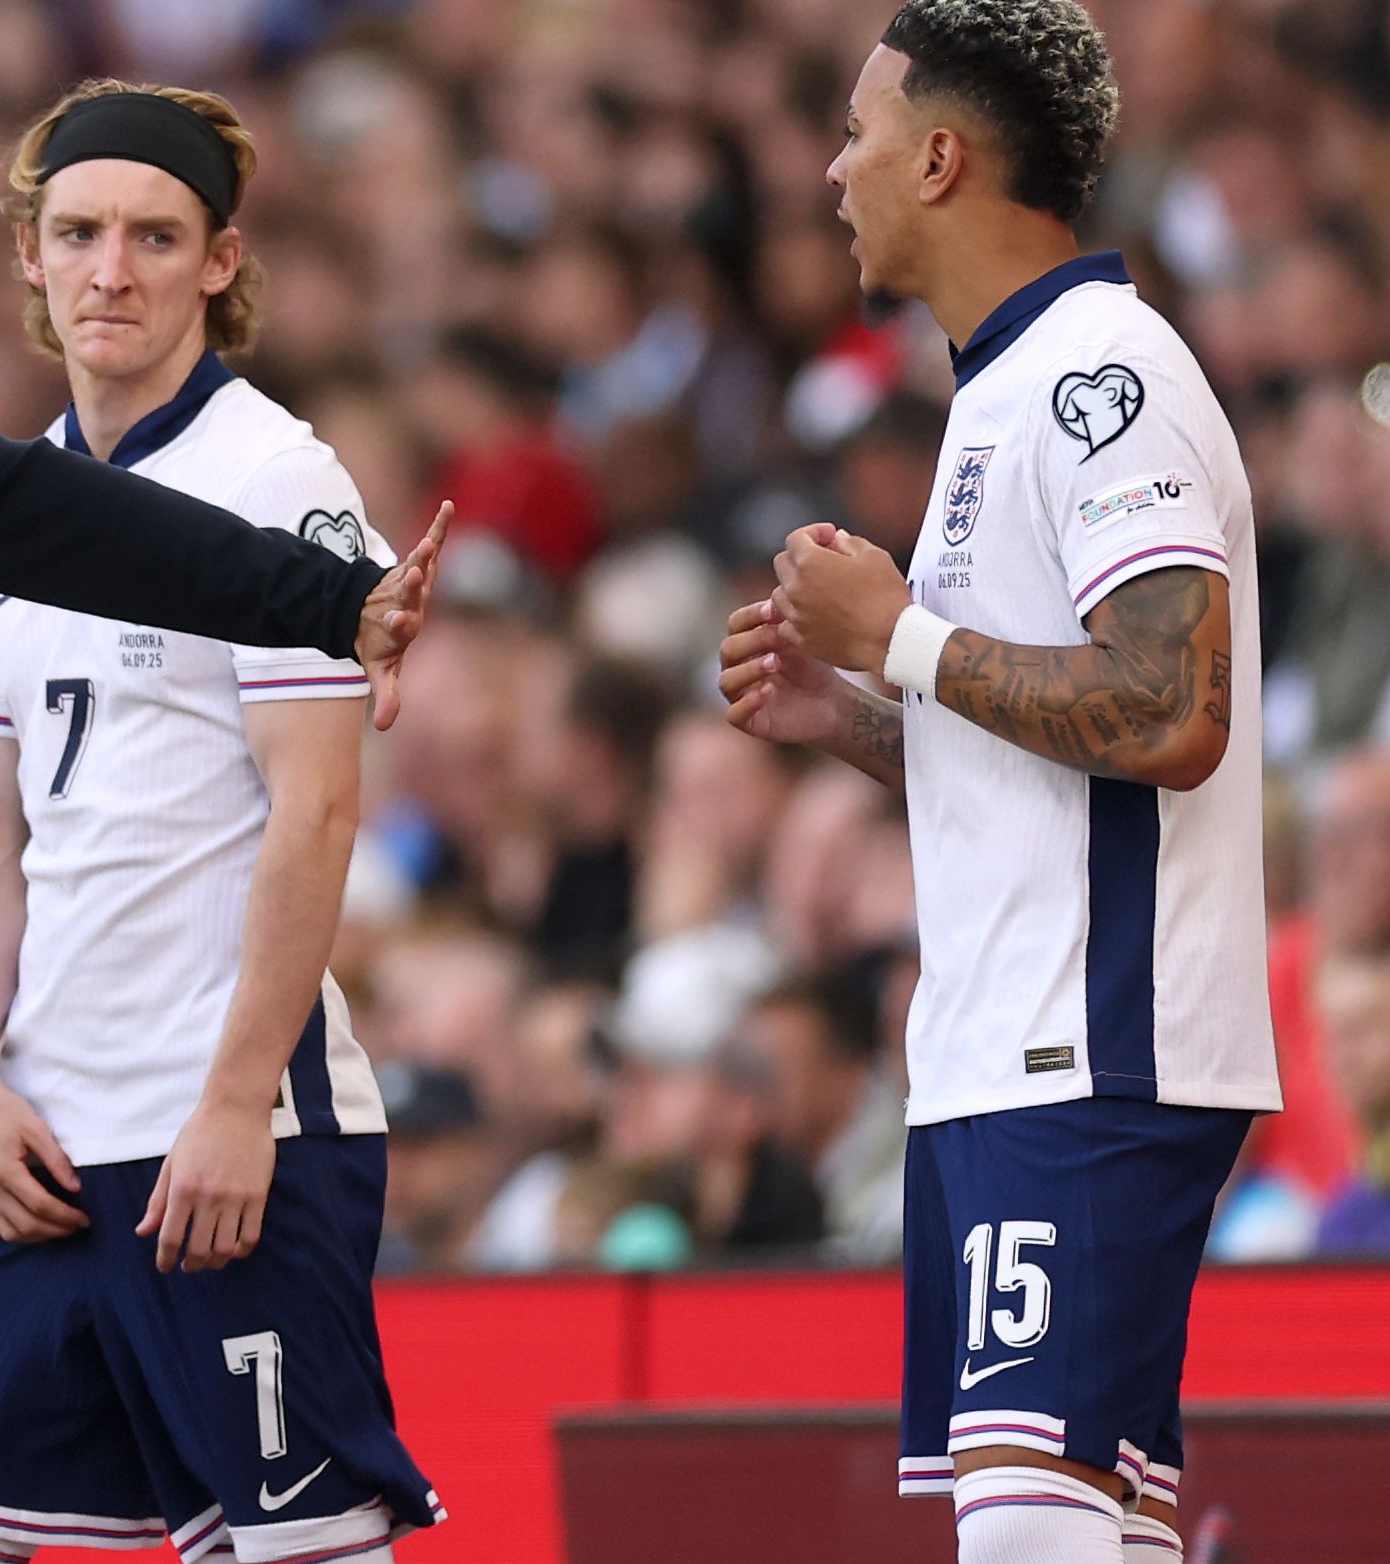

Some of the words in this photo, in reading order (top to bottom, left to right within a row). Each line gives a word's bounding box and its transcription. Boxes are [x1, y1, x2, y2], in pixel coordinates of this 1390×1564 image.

[1081, 489, 1152, 523] FOUNDATION
[119, 633, 165, 649] ANDORRA
[122, 652, 163, 668] 06.09.25
[46, 678, 96, 800] 7
[963, 1220, 1057, 1351] 15
[222, 1330, 287, 1460] 7
